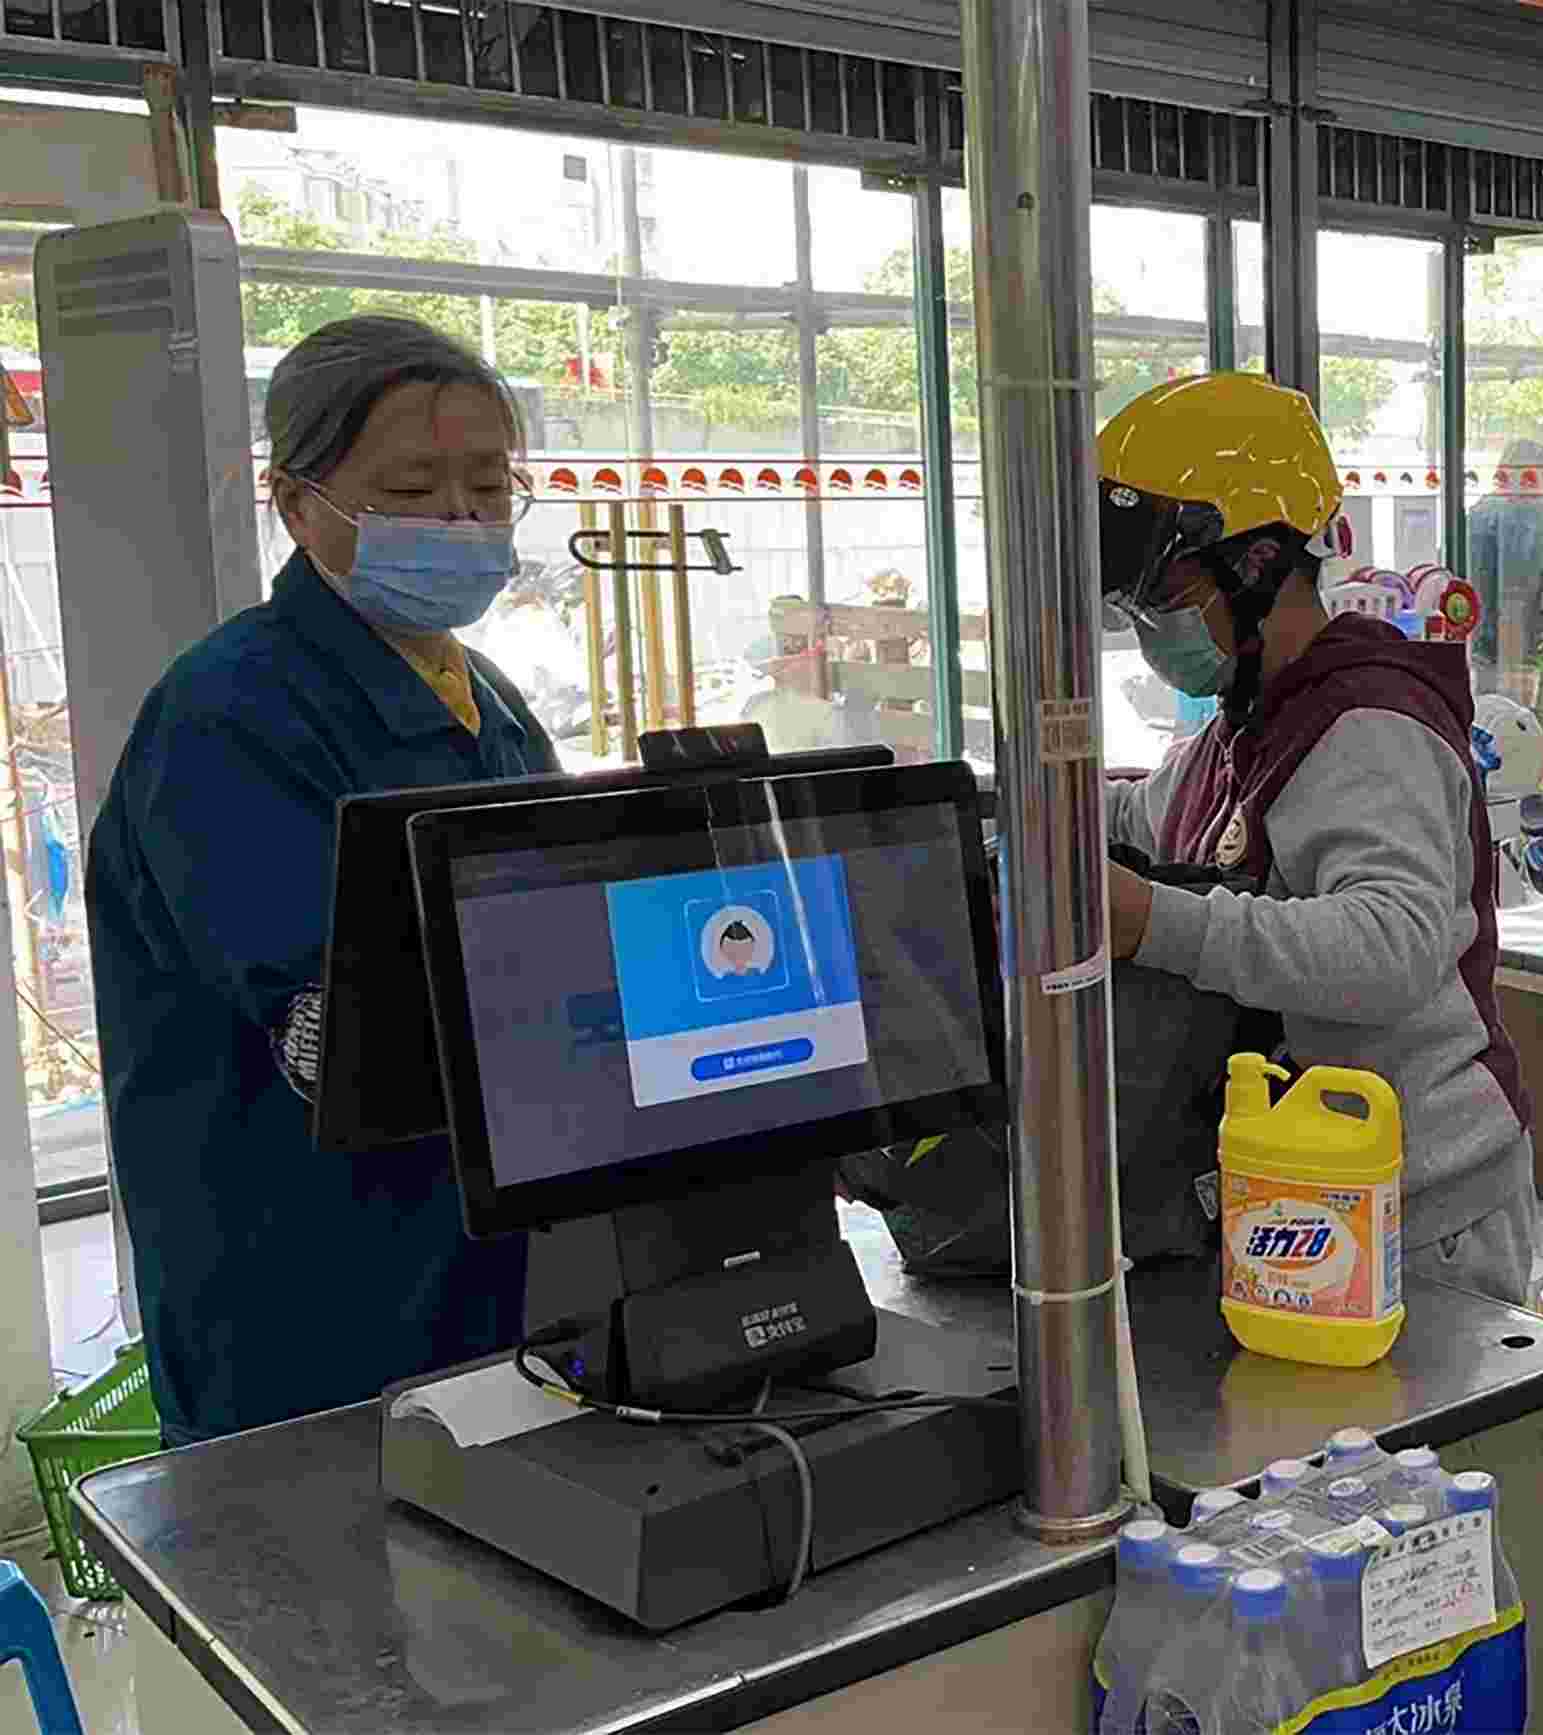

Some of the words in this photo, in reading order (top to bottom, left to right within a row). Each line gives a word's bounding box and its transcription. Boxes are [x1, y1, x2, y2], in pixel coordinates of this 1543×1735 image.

[1246, 1225, 1332, 1258] 活力28
[1365, 1679, 1464, 1735] 大冰泉
